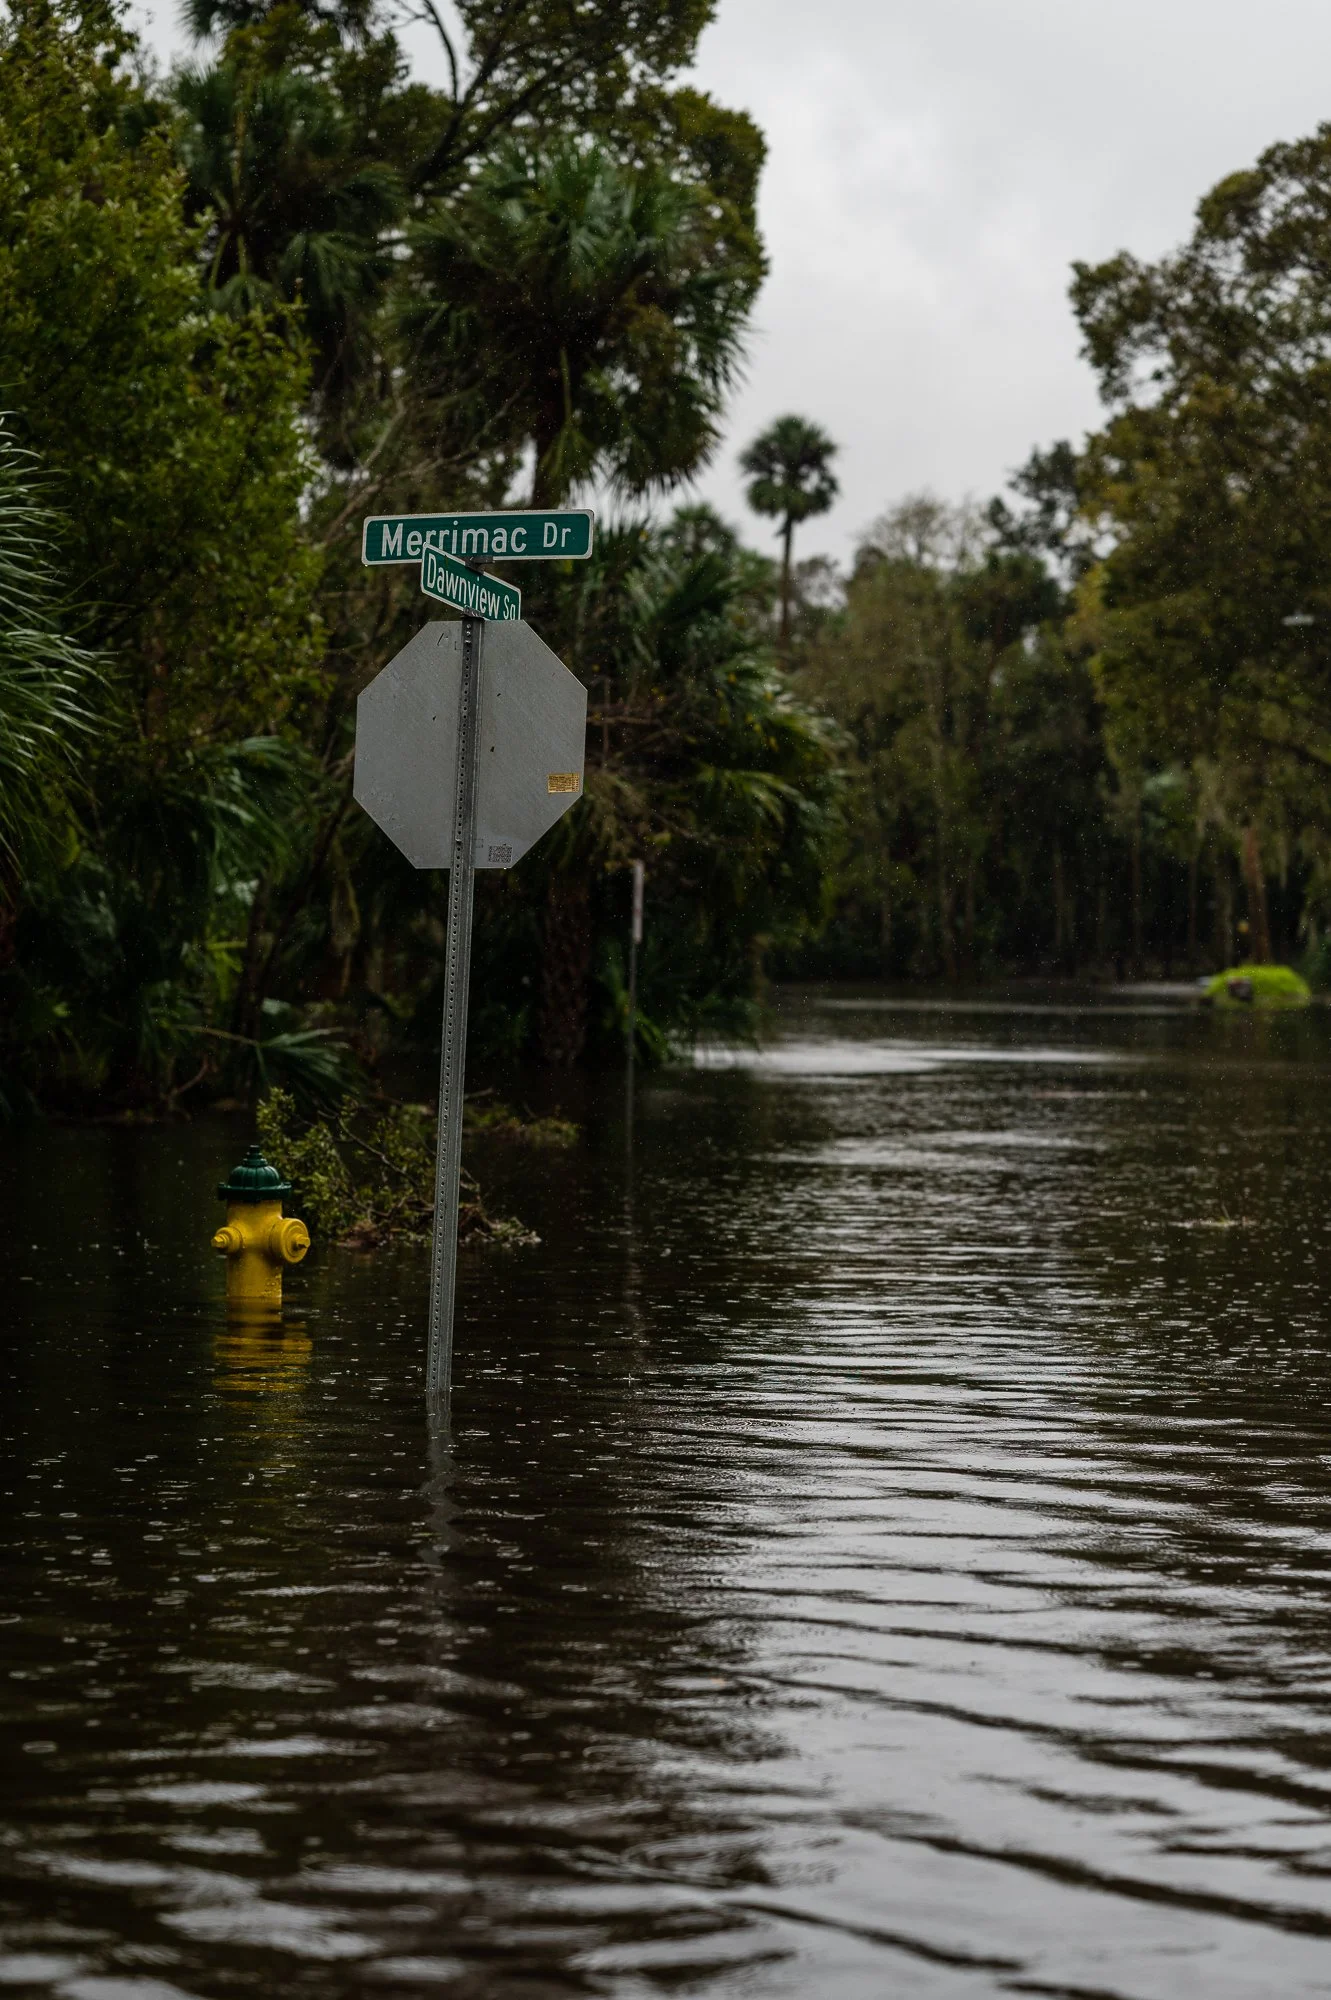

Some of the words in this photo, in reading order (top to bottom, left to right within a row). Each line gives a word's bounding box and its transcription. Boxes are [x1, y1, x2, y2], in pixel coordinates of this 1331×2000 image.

[381, 520, 527, 557] Merrimac
[543, 522, 571, 548] Dr
[426, 553, 500, 619] Dawnview
